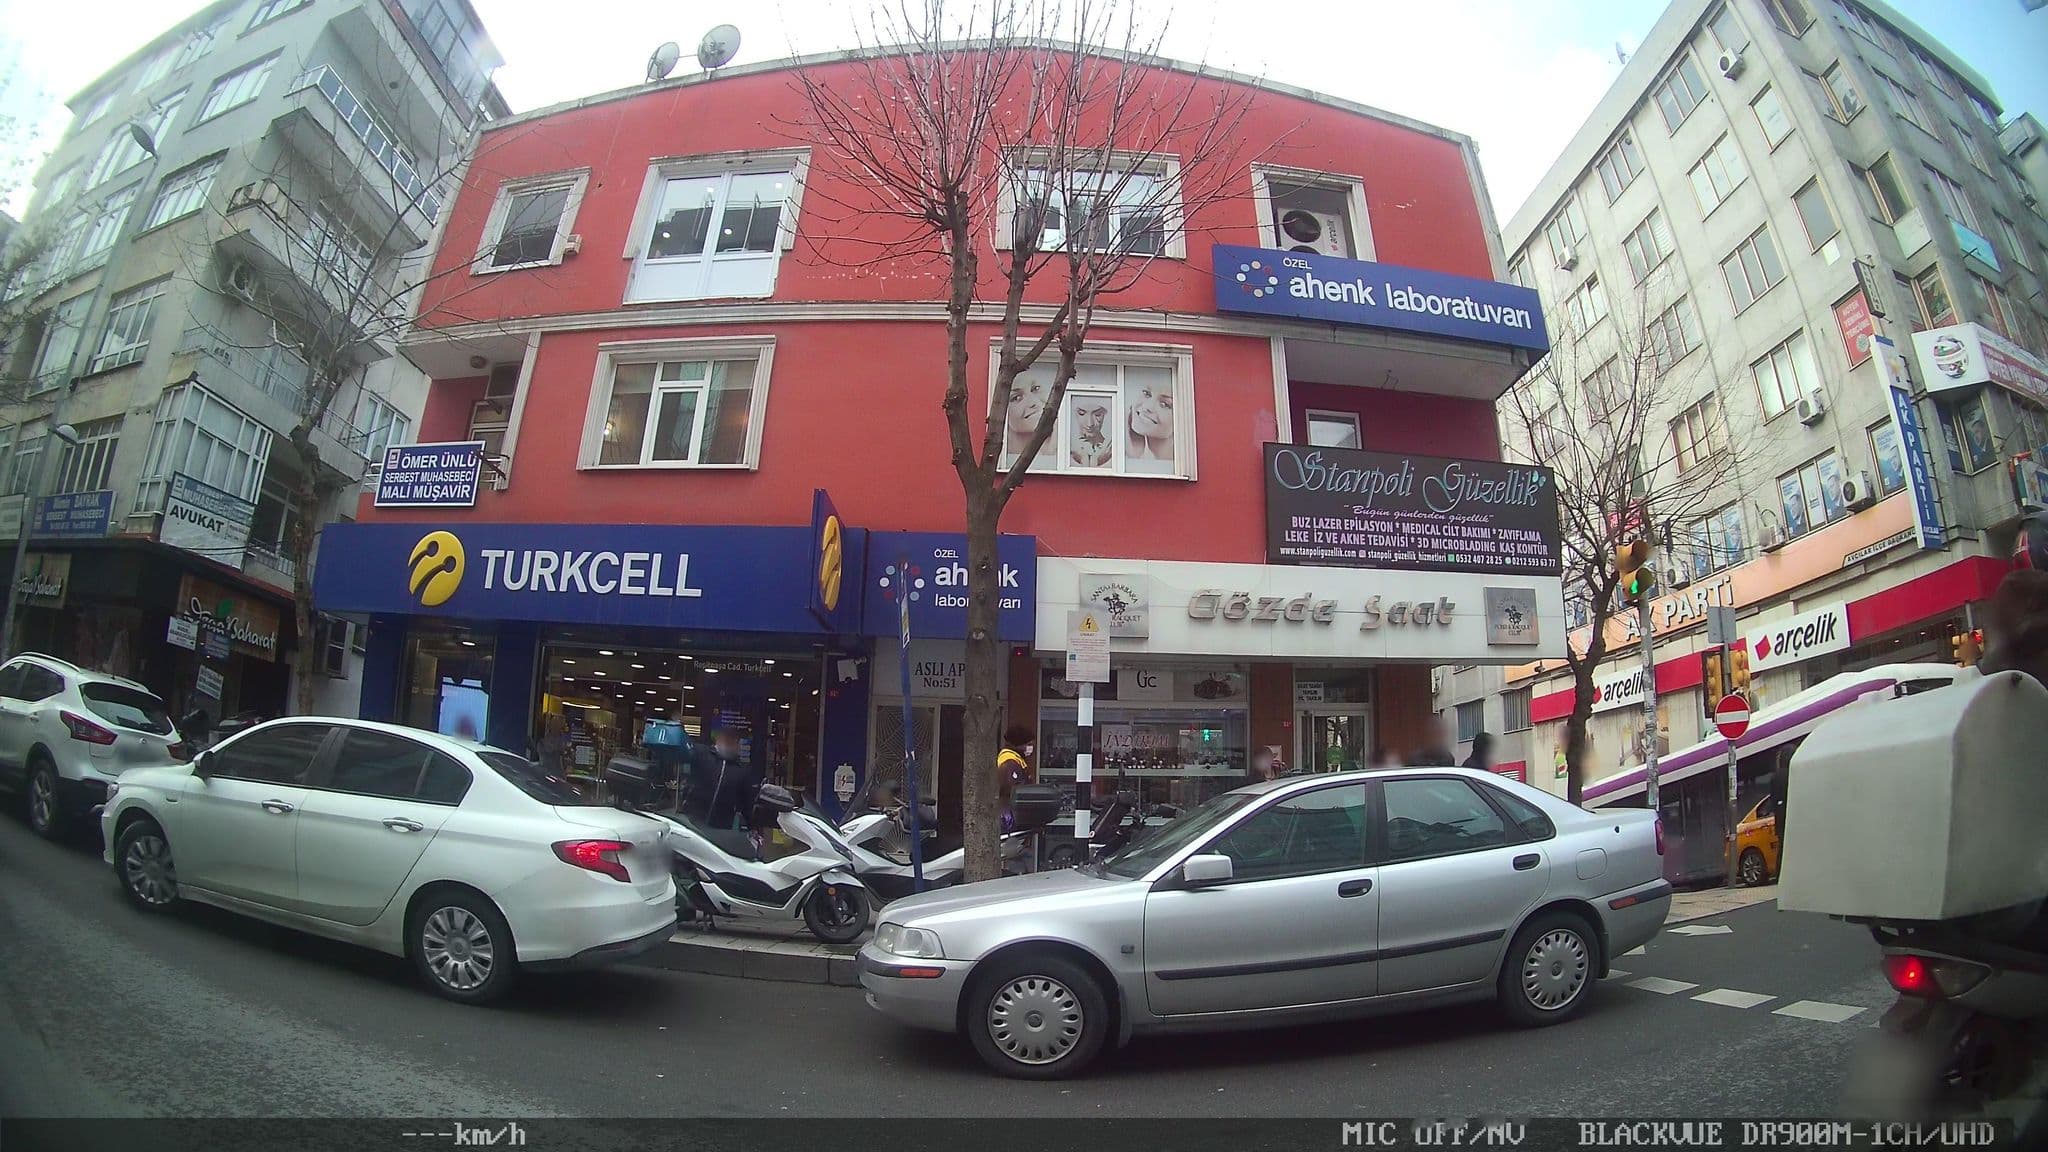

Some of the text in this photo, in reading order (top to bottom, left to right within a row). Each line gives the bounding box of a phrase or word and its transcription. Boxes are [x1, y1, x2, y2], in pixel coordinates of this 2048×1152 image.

[1283, 256, 1313, 270] ÖZEL
[1289, 272, 1532, 329] ahenk laboratuvarı
[401, 451, 477, 469] ÖMER ÜNLÜ
[1897, 393, 1931, 521] AK PARTİ
[384, 468, 475, 483] SERBEST MUHASEBECİ
[1274, 449, 1539, 513] Stanpoli Güzellik
[381, 482, 471, 501] MALİ MÜŞAVİR
[170, 505, 225, 533] AVUKAT
[1292, 516, 1541, 542] BUZ LAZER EPİLASYON MEDICAL CİLT BAKIMI ZAYIFLAMA
[934, 548, 959, 558] ÖZEL
[1285, 528, 1548, 556] LEKE İZ VE AKNE TEDAVİSİ 3D MICROBLADING KAŞ KONTÜR
[1847, 547, 1872, 562] AVCILAR
[481, 549, 702, 597] TURKCELL
[1455, 553, 1472, 563] 0532
[1473, 554, 1485, 564] 407
[1486, 555, 1494, 564] 28
[1495, 556, 1503, 565] 25
[1512, 557, 1527, 566] 0212
[1528, 557, 1539, 567] 593
[1540, 558, 1548, 567] 63
[1548, 558, 1556, 568] 77
[934, 562, 1018, 588] ahk
[934, 594, 1021, 609] laborvarı
[1187, 589, 1338, 626] Gözde
[1360, 594, 1456, 632] Saat
[1664, 576, 1734, 628] PARTİ
[1774, 612, 1838, 657] arçelik
[914, 662, 943, 676] ASLI
[923, 677, 956, 688] No:51
